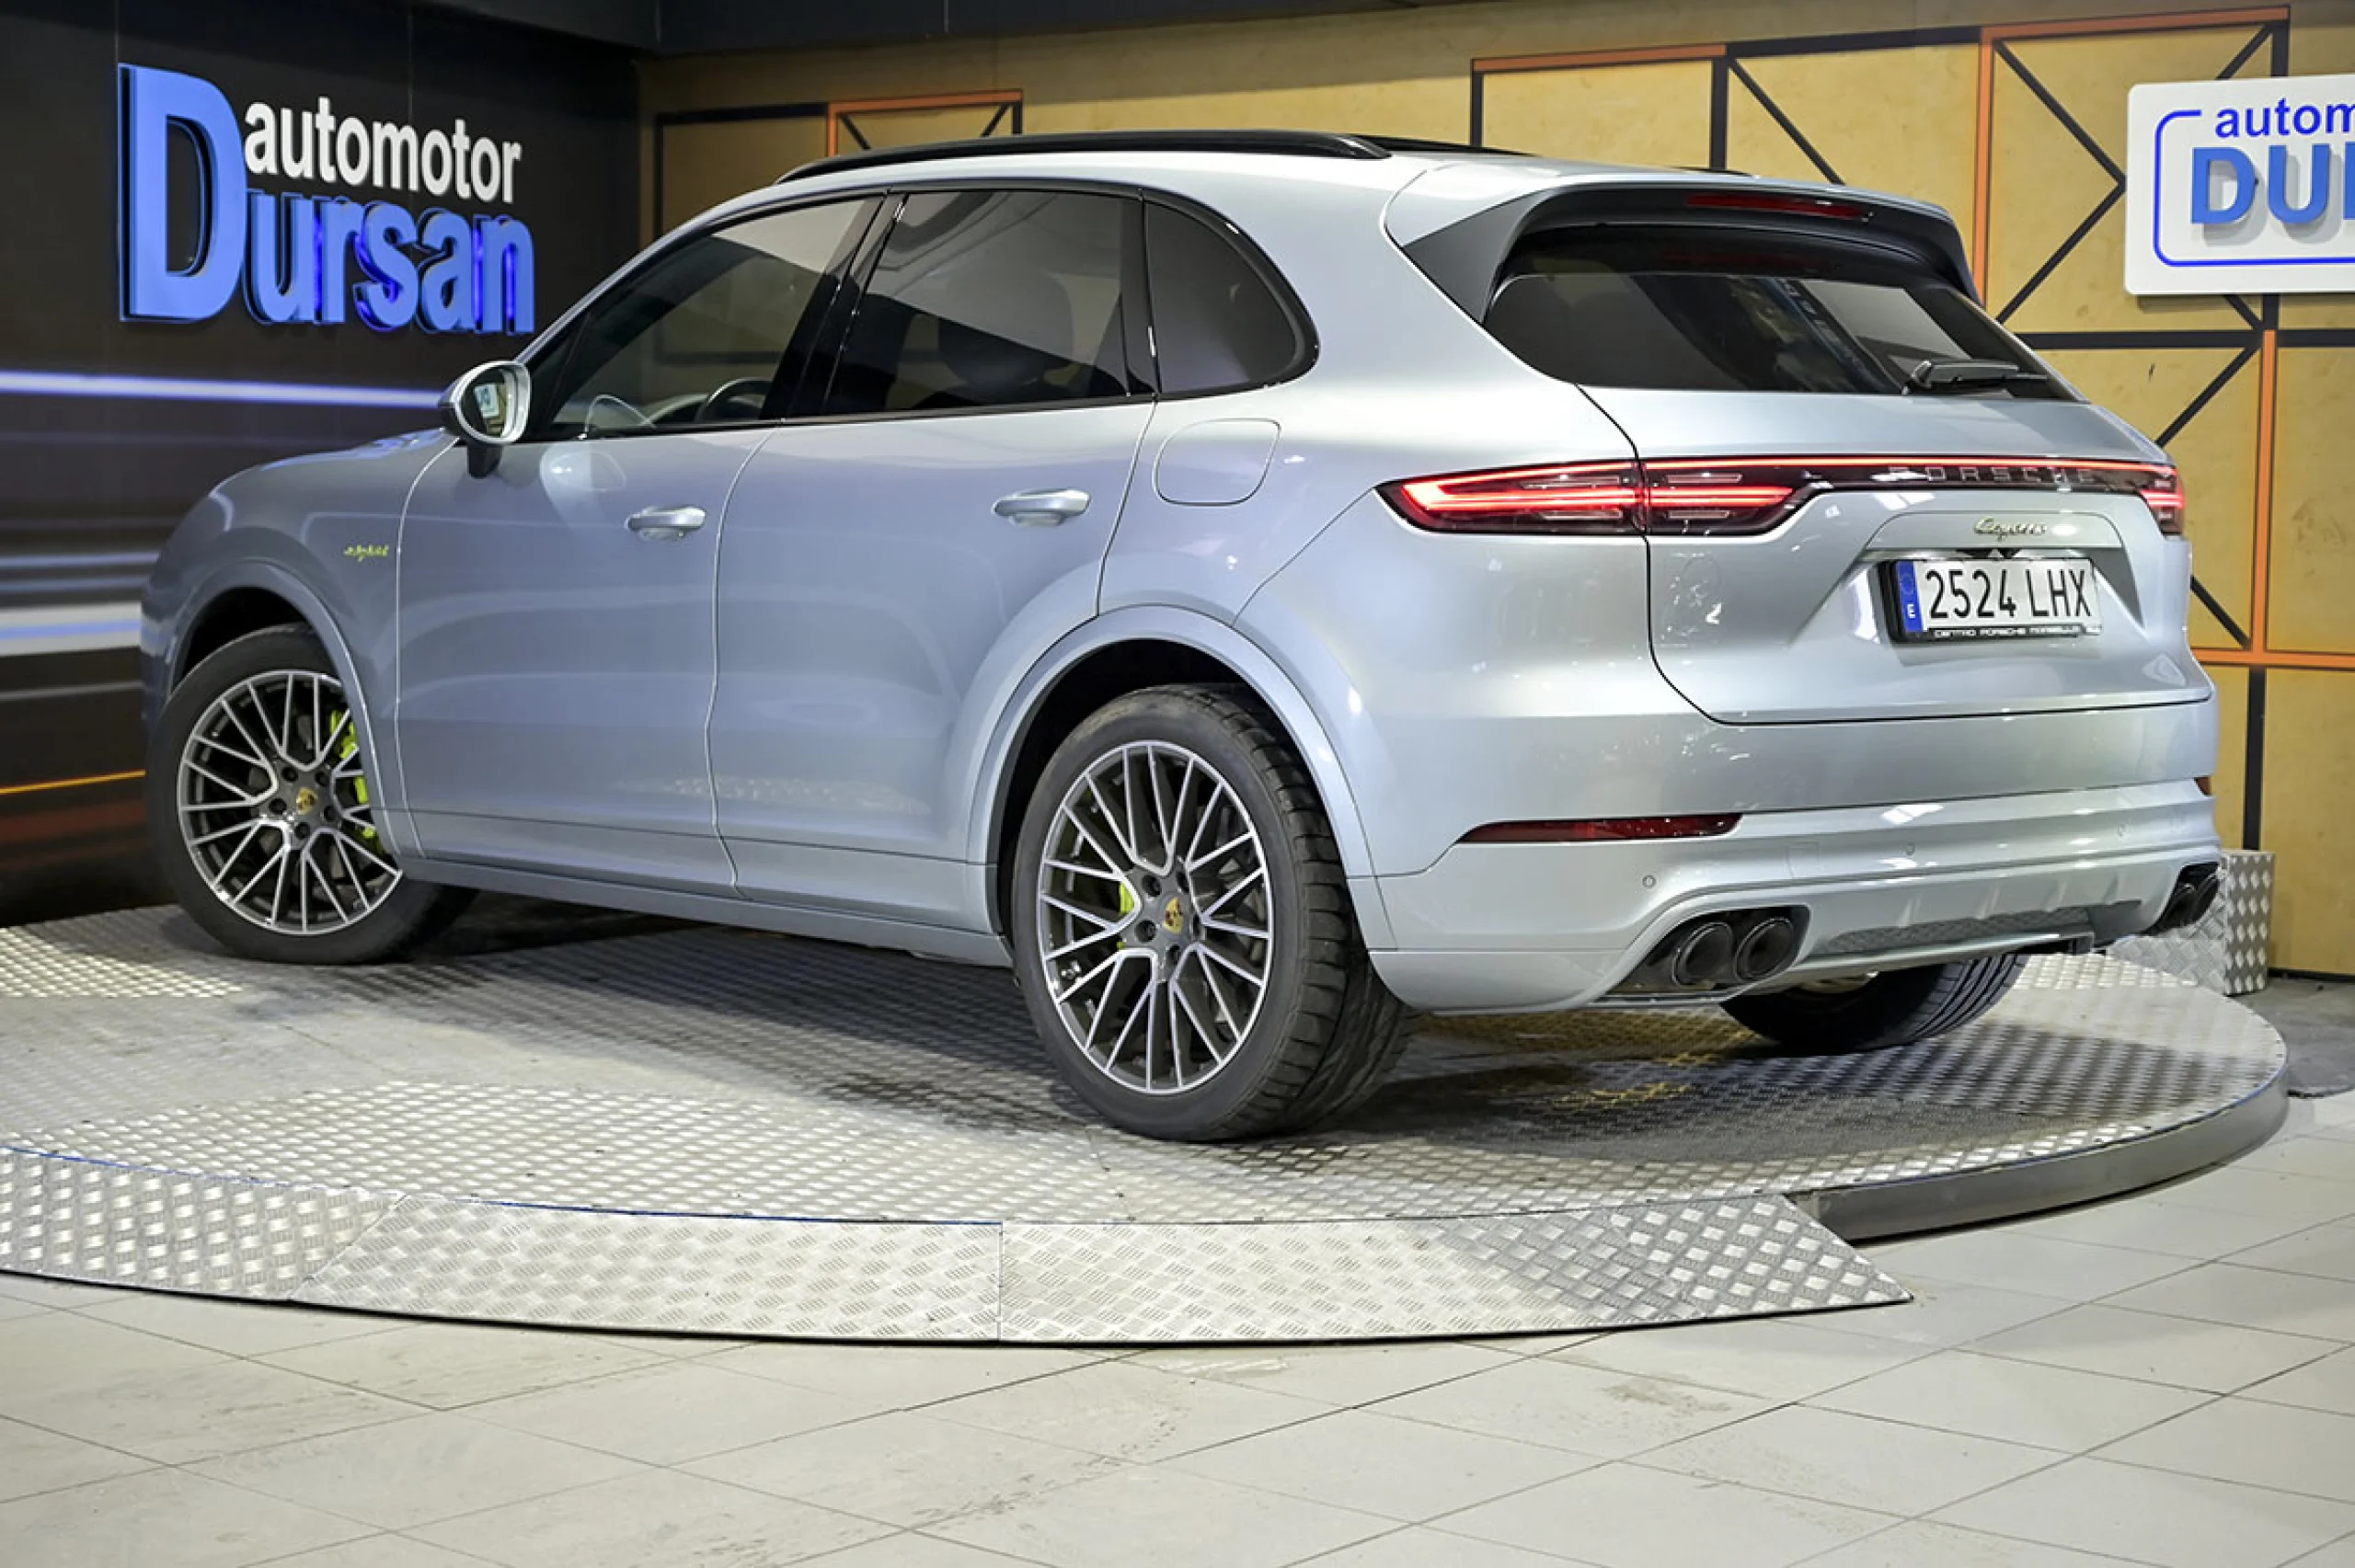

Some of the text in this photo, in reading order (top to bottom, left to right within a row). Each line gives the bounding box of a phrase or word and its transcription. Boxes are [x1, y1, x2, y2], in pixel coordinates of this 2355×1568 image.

[244, 96, 523, 204] automotor
[2190, 140, 2355, 224] DU
[118, 62, 536, 336] Dursan
[1907, 603, 1916, 619] E
[1925, 568, 2092, 619] 2524 LHX
